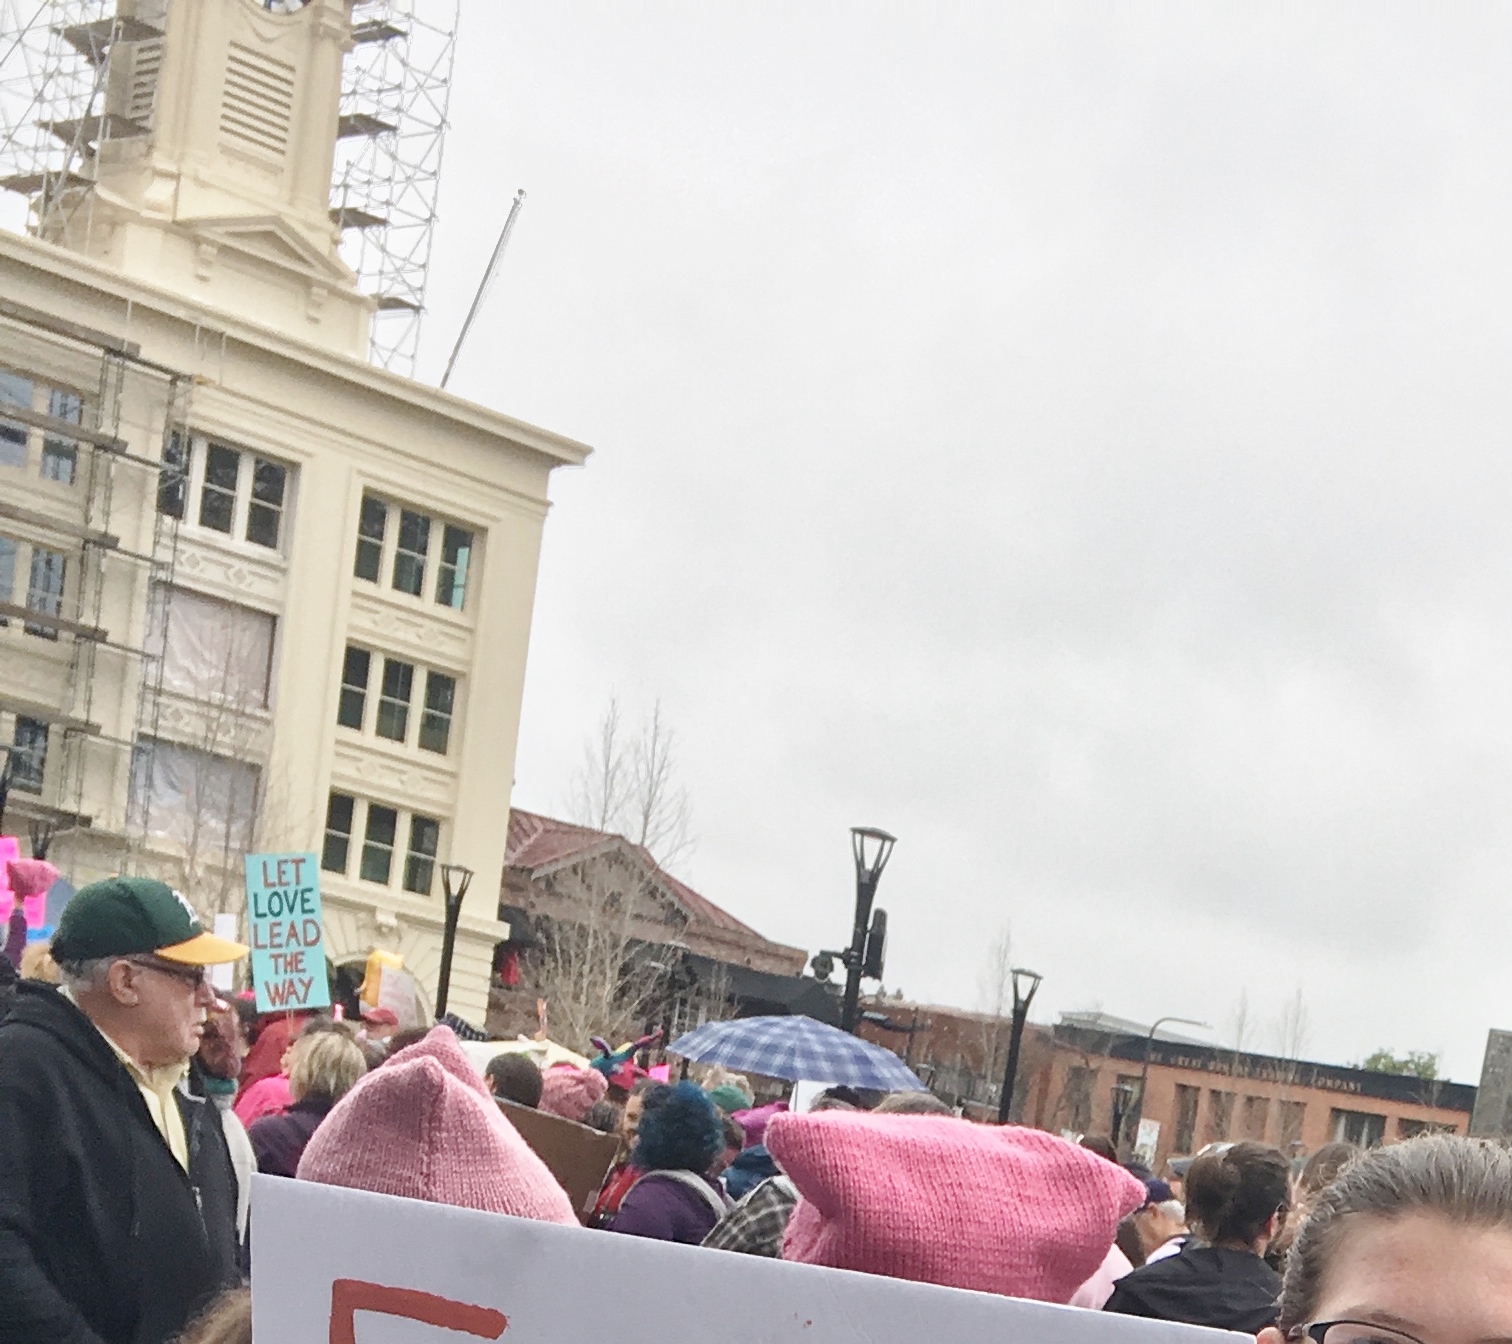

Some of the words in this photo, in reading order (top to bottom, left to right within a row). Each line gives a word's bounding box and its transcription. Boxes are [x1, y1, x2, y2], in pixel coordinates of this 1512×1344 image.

[262, 858, 306, 888] LET
[253, 887, 316, 919] LOVE
[252, 918, 321, 950] LEAD
[269, 951, 307, 975] THE
[264, 976, 314, 1007] WAY
